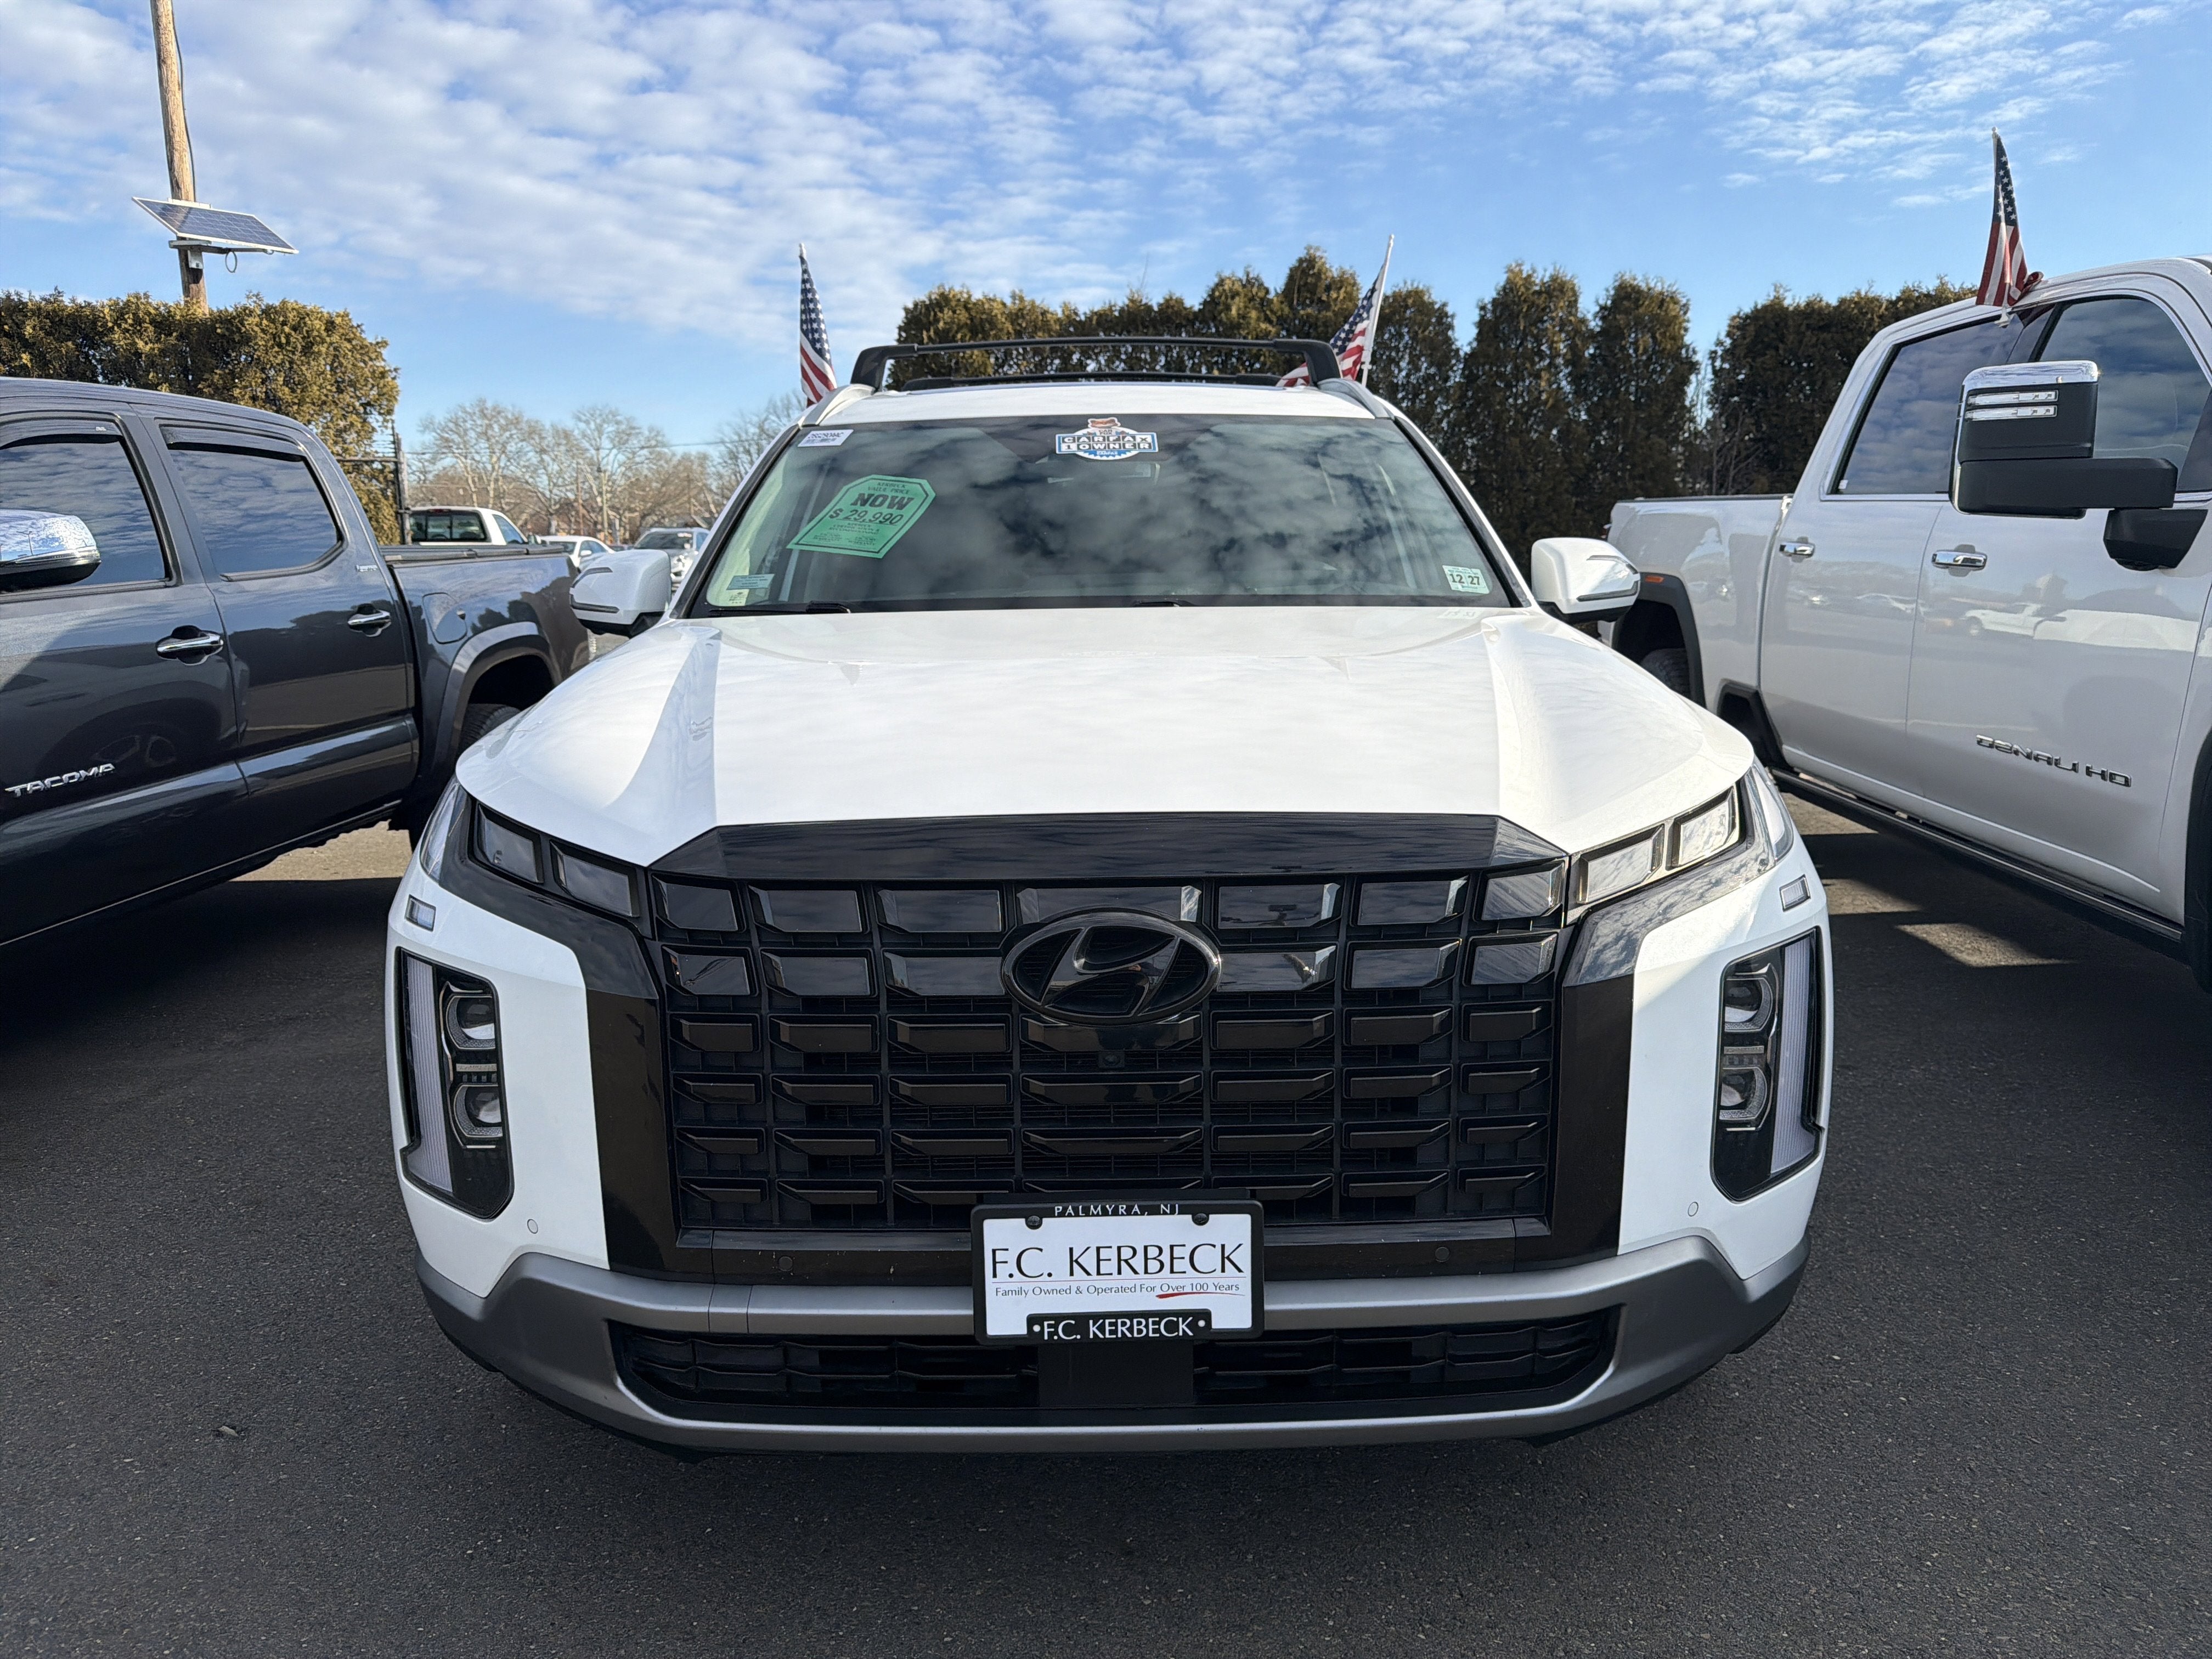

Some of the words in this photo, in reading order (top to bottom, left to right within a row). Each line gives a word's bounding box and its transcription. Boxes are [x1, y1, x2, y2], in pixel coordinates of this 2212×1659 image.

[850, 493, 915, 511] NOW
[843, 509, 904, 525] 29,990
[1449, 573, 1465, 584] 12
[1468, 575, 1480, 586] 27
[1976, 734, 2079, 774] DENALI
[2086, 764, 2131, 787] HD
[5, 763, 116, 797] TACOMA
[1054, 1203, 1148, 1216] PALMYRA,
[1160, 1204, 1178, 1216] NJ
[991, 1247, 1053, 1279] F.C.
[1069, 1243, 1244, 1277] KERBECK
[996, 1286, 1029, 1298] Family
[1032, 1285, 1071, 1295] Owned
[1075, 1285, 1083, 1294] &
[1087, 1283, 1136, 1296] Operated
[1140, 1283, 1156, 1293] For
[1160, 1283, 1186, 1292] Over
[1190, 1282, 1209, 1291] 100
[1212, 1282, 1240, 1291] Years
[1043, 1319, 1081, 1340] F.C.
[1089, 1317, 1194, 1339] KERBECK
